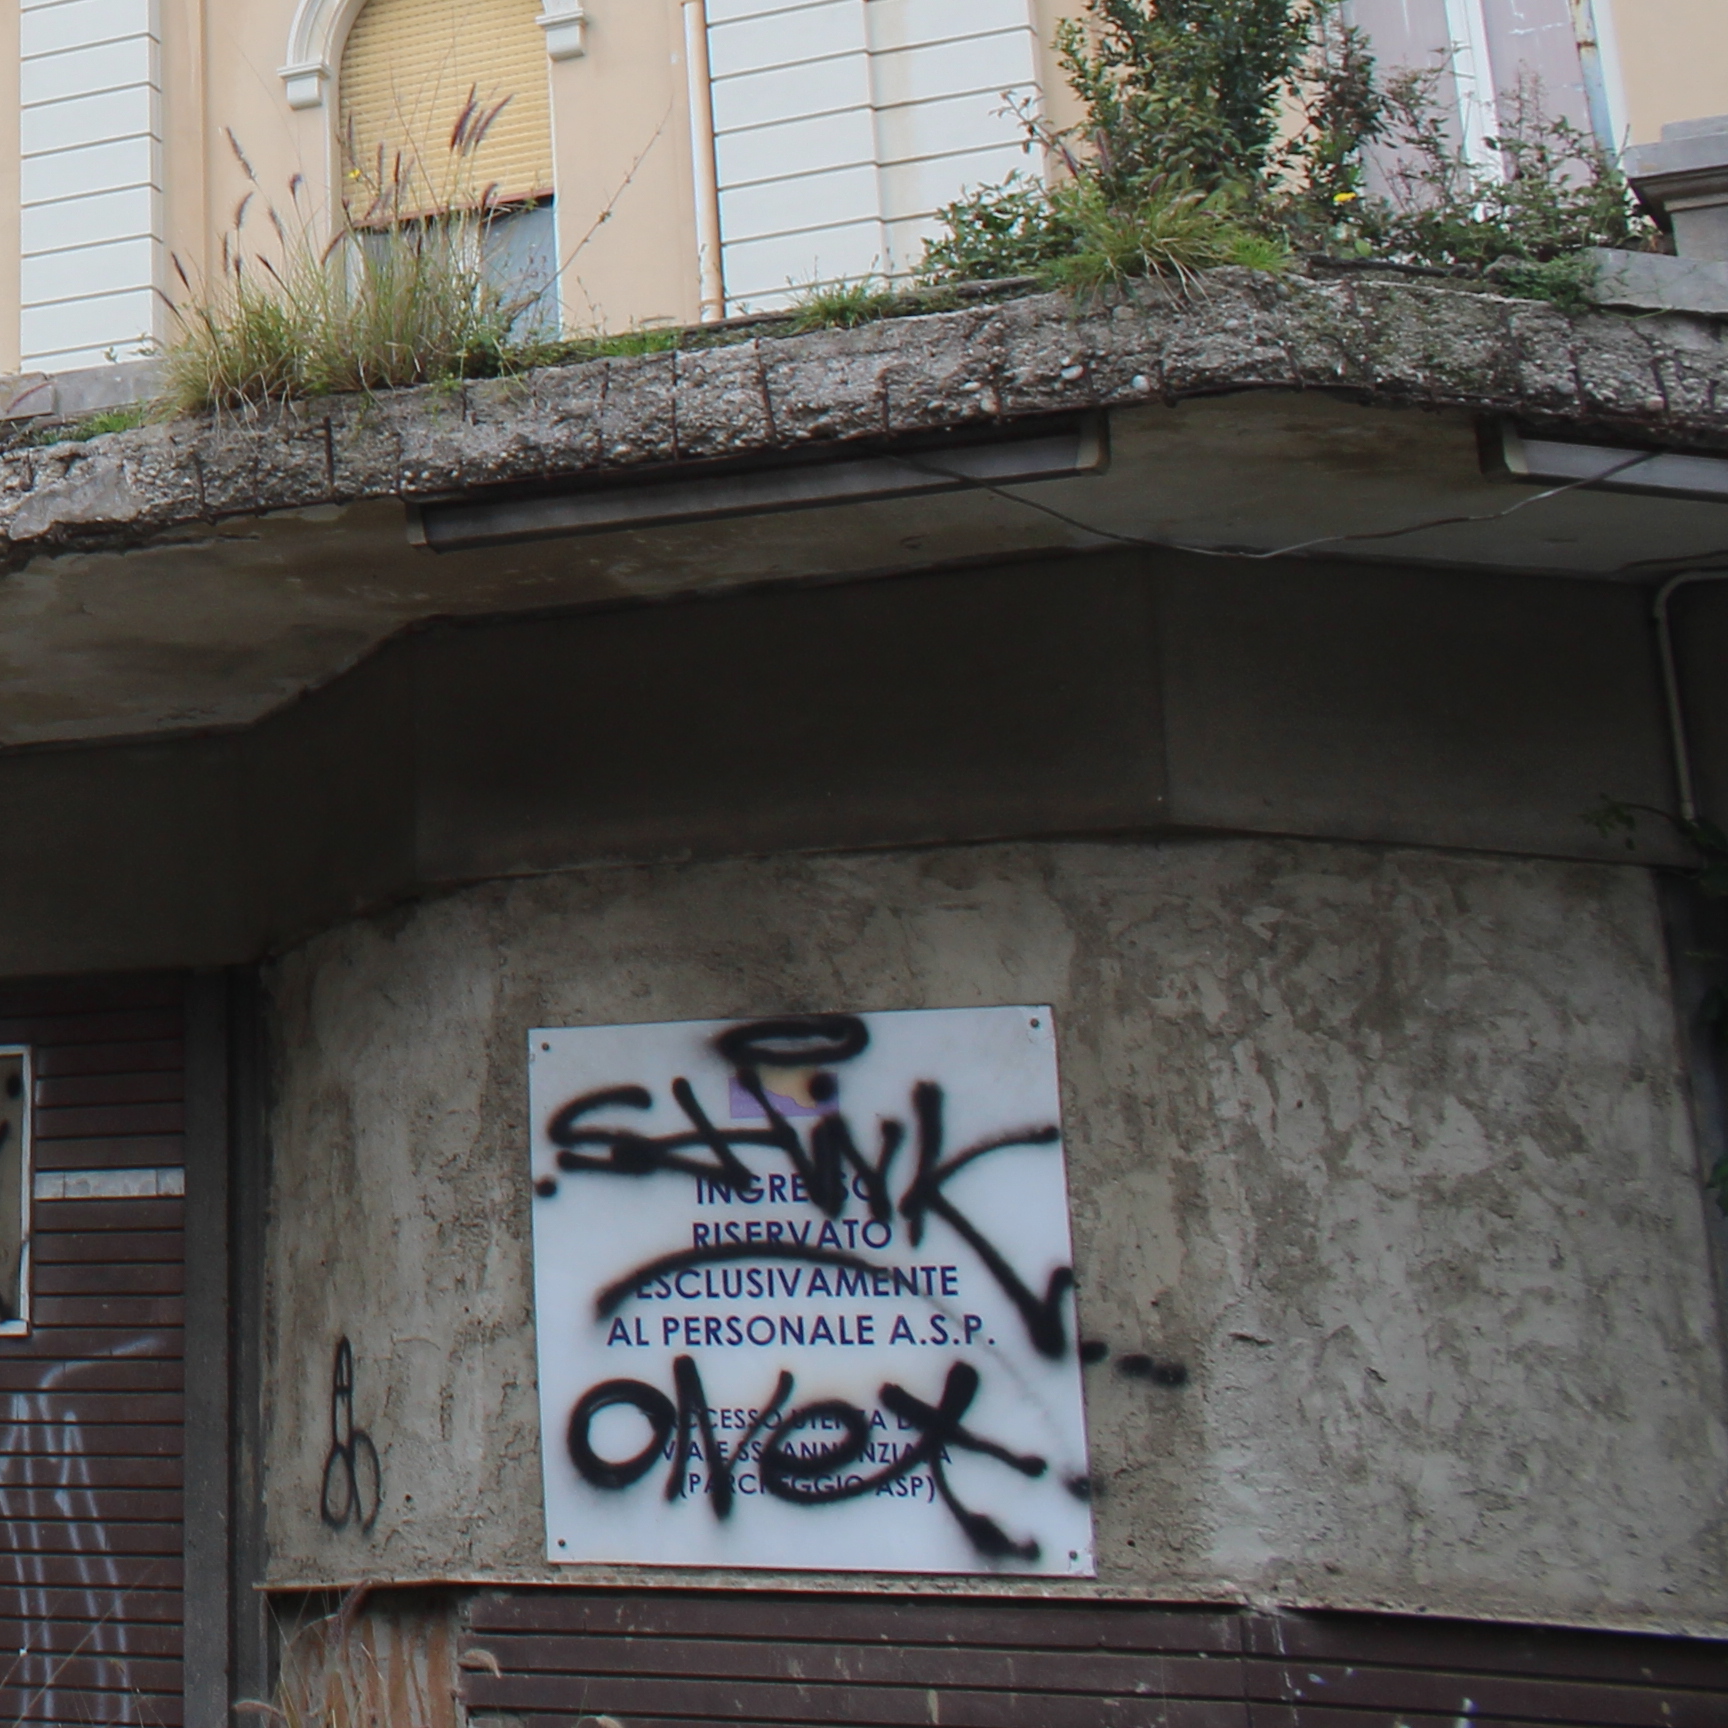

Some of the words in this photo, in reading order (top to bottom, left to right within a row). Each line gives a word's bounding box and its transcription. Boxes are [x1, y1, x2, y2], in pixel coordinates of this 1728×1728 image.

[692, 1219, 892, 1249] RISERVATO
[636, 1266, 959, 1299] ESCLUSIVAMENTE
[607, 1317, 649, 1347] AL
[662, 1315, 875, 1347] PERSONALE
[889, 1314, 996, 1346] A.S.P.
[876, 1474, 936, 1502] ASP)
